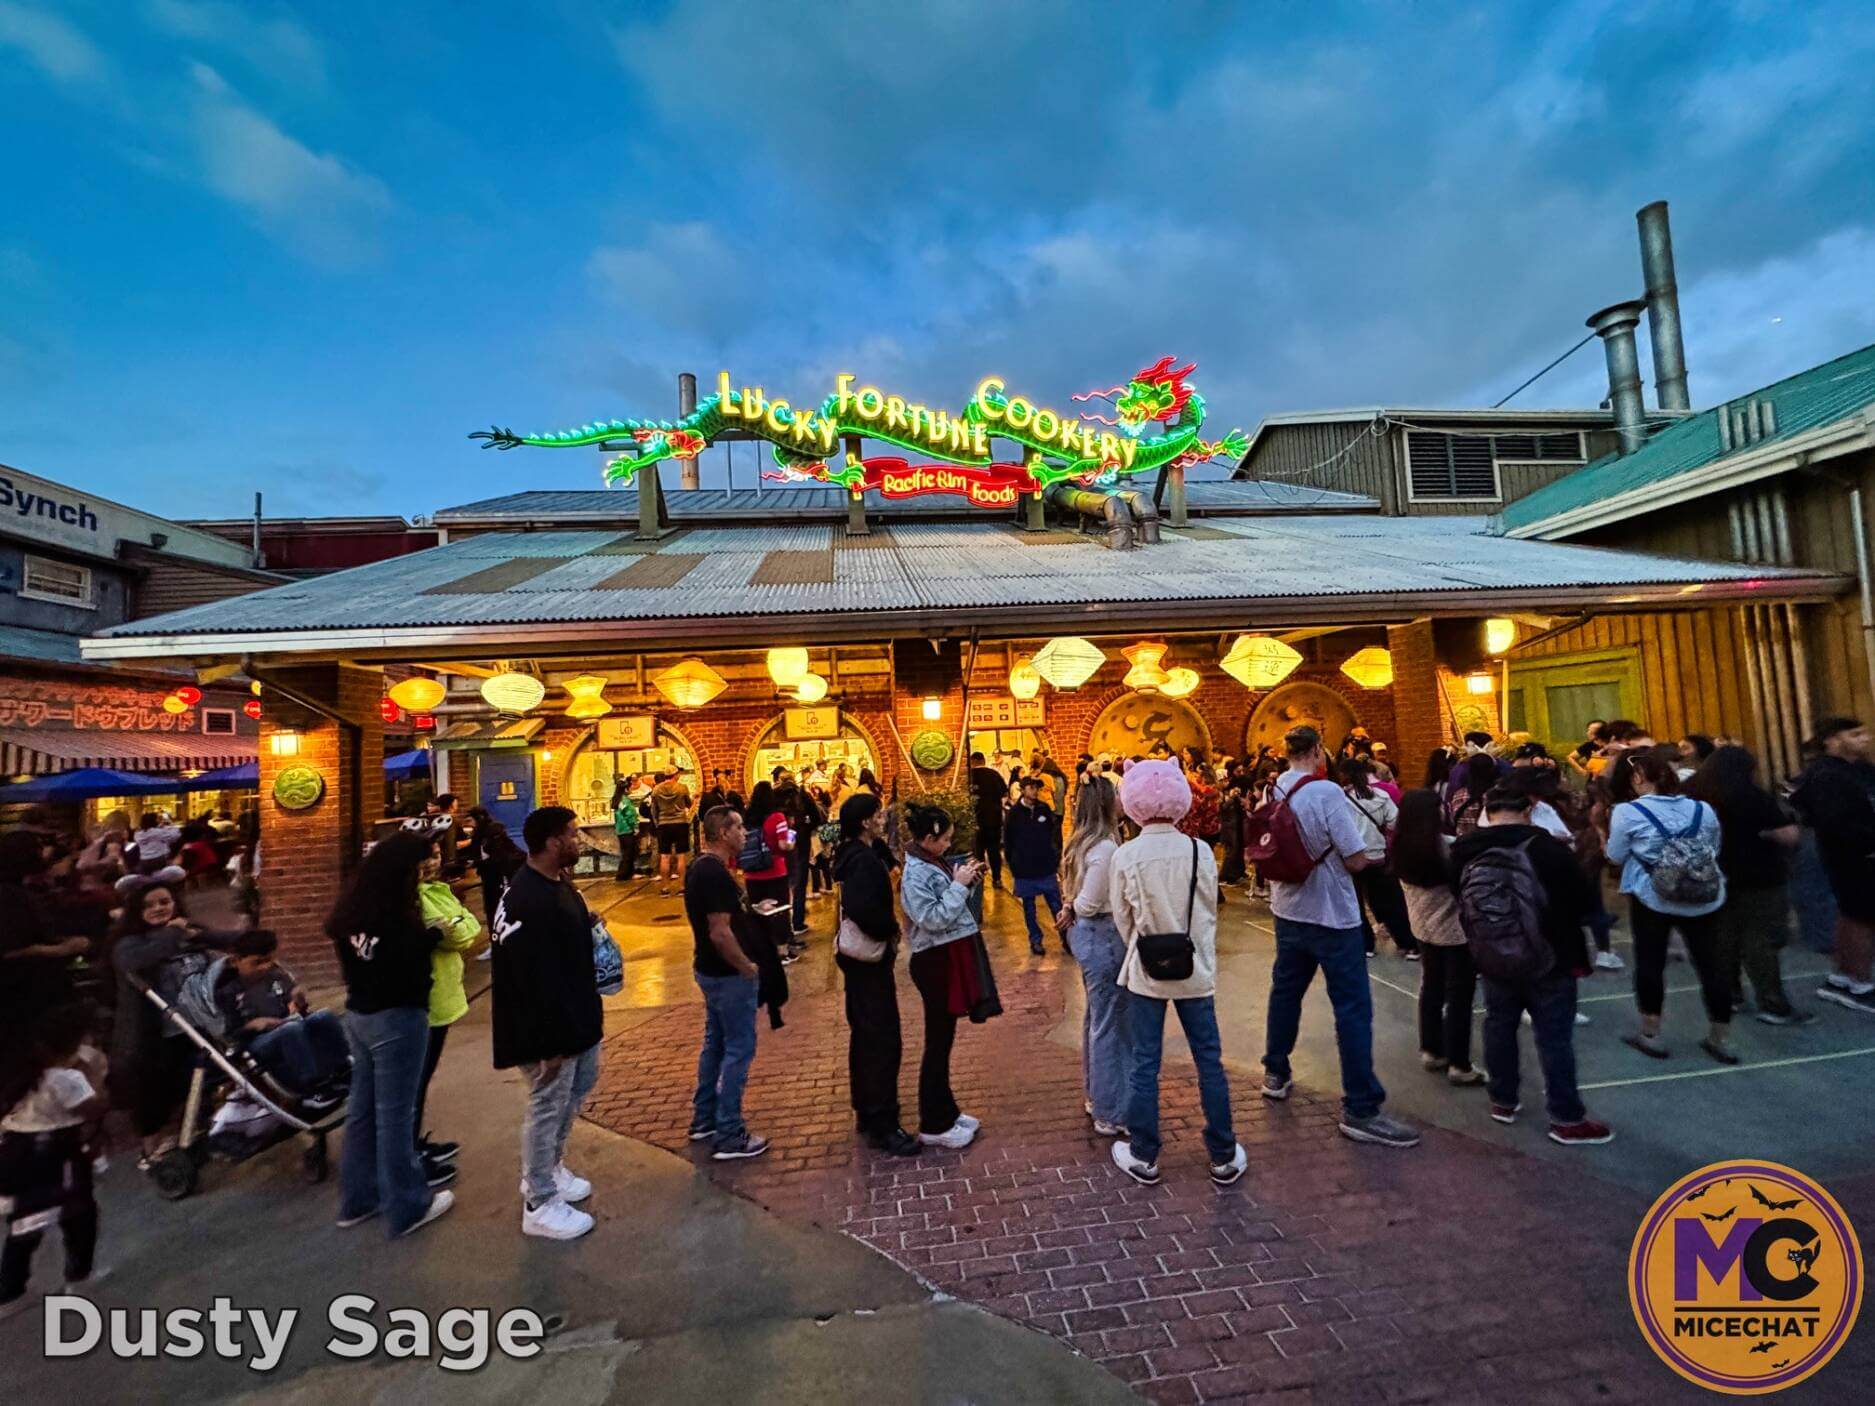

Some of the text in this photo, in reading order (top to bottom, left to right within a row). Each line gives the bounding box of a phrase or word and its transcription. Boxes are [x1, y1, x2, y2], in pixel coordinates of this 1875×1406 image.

[718, 371, 1138, 469] LUCKY FORTUNE COOKERY
[0, 477, 98, 531] Synch
[883, 468, 967, 492] Pacific Rim
